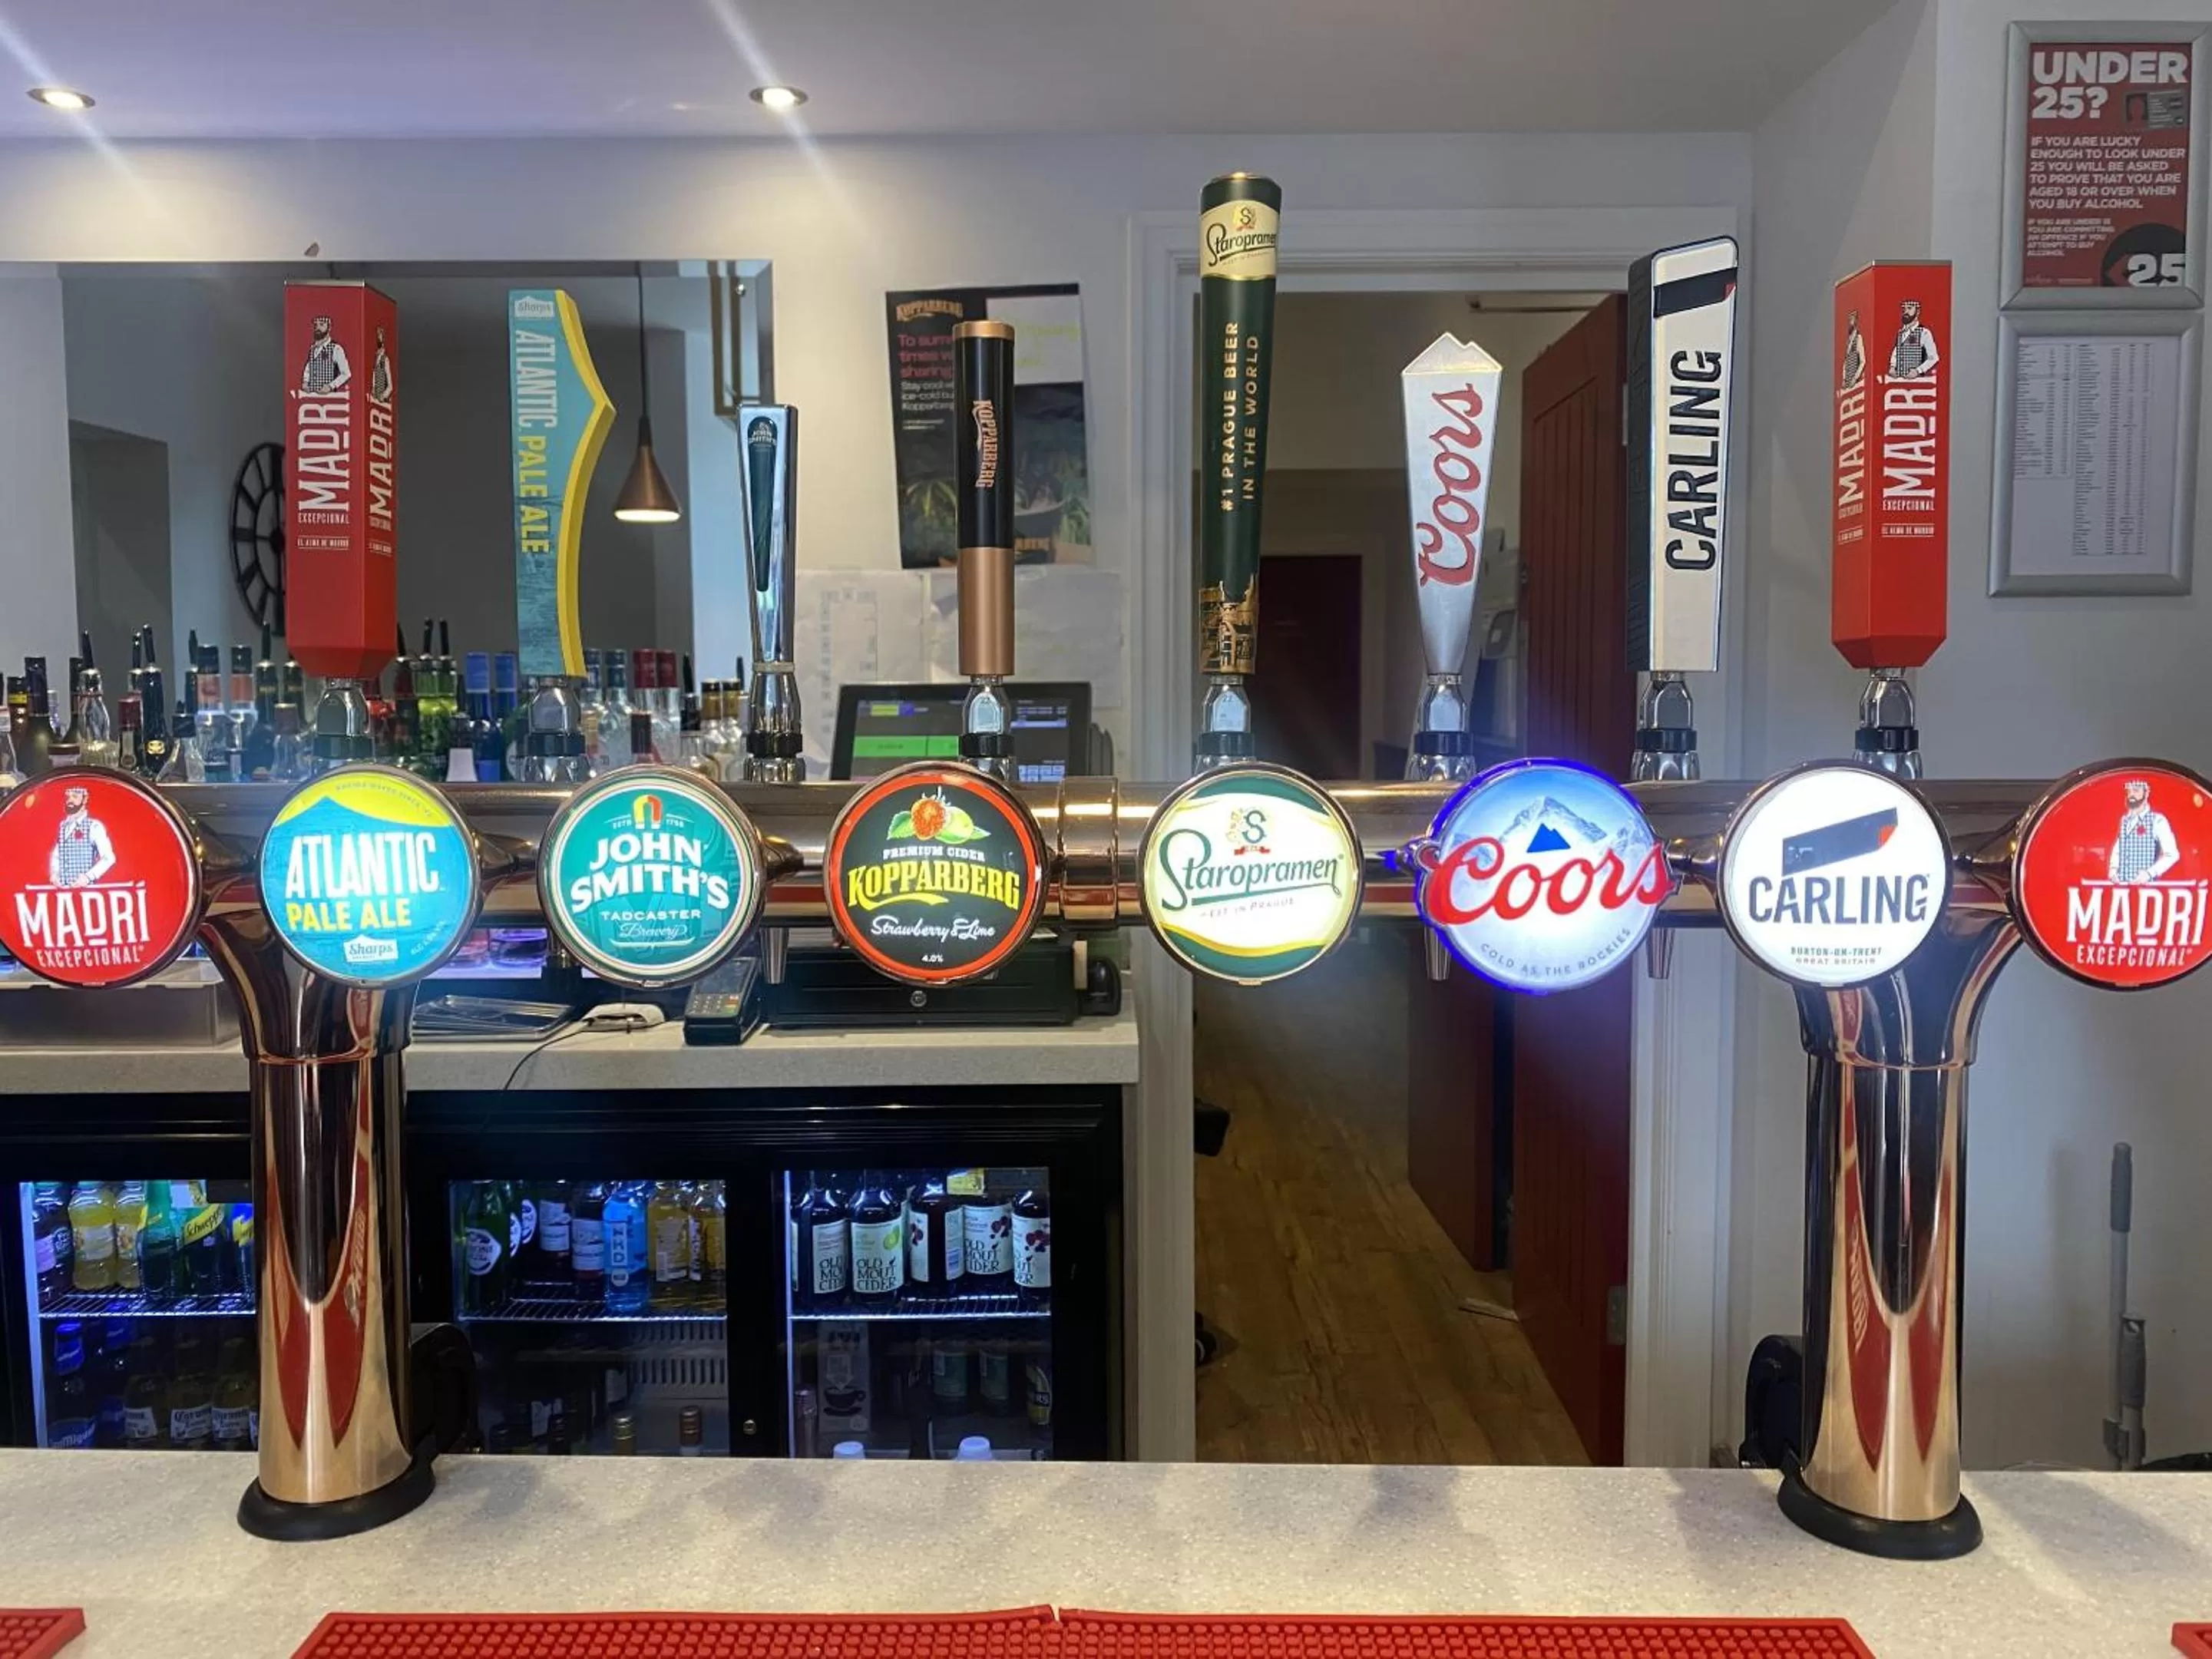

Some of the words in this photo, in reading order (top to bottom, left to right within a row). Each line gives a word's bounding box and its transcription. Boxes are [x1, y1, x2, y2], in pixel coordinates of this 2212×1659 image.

[2032, 51, 2188, 84] UNDER
[2032, 86, 2108, 119] 25?
[2030, 149, 2083, 159] ENOUGH
[2085, 149, 2102, 158] TO
[2105, 148, 2138, 158] LOOK
[2141, 148, 2186, 158] UNDER
[2031, 137, 2043, 146] IF
[2045, 137, 2071, 146] YOU
[2073, 137, 2098, 146] ARE
[2100, 136, 2141, 146] LUCKY
[2029, 174, 2047, 183] TO
[2048, 174, 2090, 183] PROVE
[2092, 174, 2124, 183] THAT
[2127, 174, 2153, 183] YOU
[2155, 173, 2181, 183] ARE
[2030, 162, 2045, 171] 25
[2048, 162, 2072, 171] YOU
[2075, 161, 2105, 171] WILL
[2108, 161, 2124, 171] BE
[2126, 161, 2169, 171] ASKED
[2028, 200, 2055, 209] YOU
[2057, 200, 2082, 208] BUY
[2029, 187, 2063, 197] AGED
[2067, 187, 2077, 197] 18
[2080, 187, 2098, 196] OR
[2101, 187, 2134, 196] OVER
[2137, 187, 2177, 196] WHEN
[2128, 253, 2186, 287] 25
[898, 335, 917, 347] To
[1224, 322, 1239, 378] BEER
[515, 329, 558, 428] ATLANTIC
[1245, 336, 1259, 415] WORLD
[971, 399, 998, 489] KOPPARBERG
[1222, 389, 1238, 478] PRAGUE
[1243, 427, 1257, 468] THE
[518, 435, 548, 498] PALE
[1665, 350, 1722, 570] CARLING
[1221, 489, 1235, 511] #1
[1242, 478, 1255, 500] IN
[1417, 382, 1483, 587] Coors
[521, 504, 550, 554] ALE
[285, 831, 440, 899] ATLANTIC
[590, 832, 702, 870] JOHN
[883, 846, 944, 860] PREMIUM
[947, 847, 986, 861] CIDER
[848, 860, 1020, 911] KOPPARBERG
[1159, 828, 1342, 912] Staropramen
[1419, 836, 1675, 925] Coors
[570, 864, 730, 914] SMITH'S
[1748, 874, 1929, 925] CARLING
[14, 881, 150, 948] MADRÍ
[286, 901, 352, 932] PALE
[360, 898, 412, 930] ALE
[601, 909, 701, 920] TADCASTER
[871, 914, 951, 943] Strawberry
[958, 919, 996, 940] Lime
[2066, 879, 2209, 946] MADRÍ
[620, 922, 688, 940] Brewery
[36, 948, 141, 968] EXCEPCIONAL
[921, 954, 944, 963] 4.0%
[1481, 943, 1515, 968] COLD
[1522, 963, 1538, 976] AS
[1545, 965, 1571, 977] THE
[1579, 927, 1632, 970] ROCKIES
[1790, 946, 1882, 957] BURTON-ON-TRENT
[2076, 945, 2187, 968] EXCEPCIONAL
[856, 1257, 882, 1268] OLD
[857, 1264, 896, 1280] MOUT
[856, 1277, 896, 1291] CIDER
